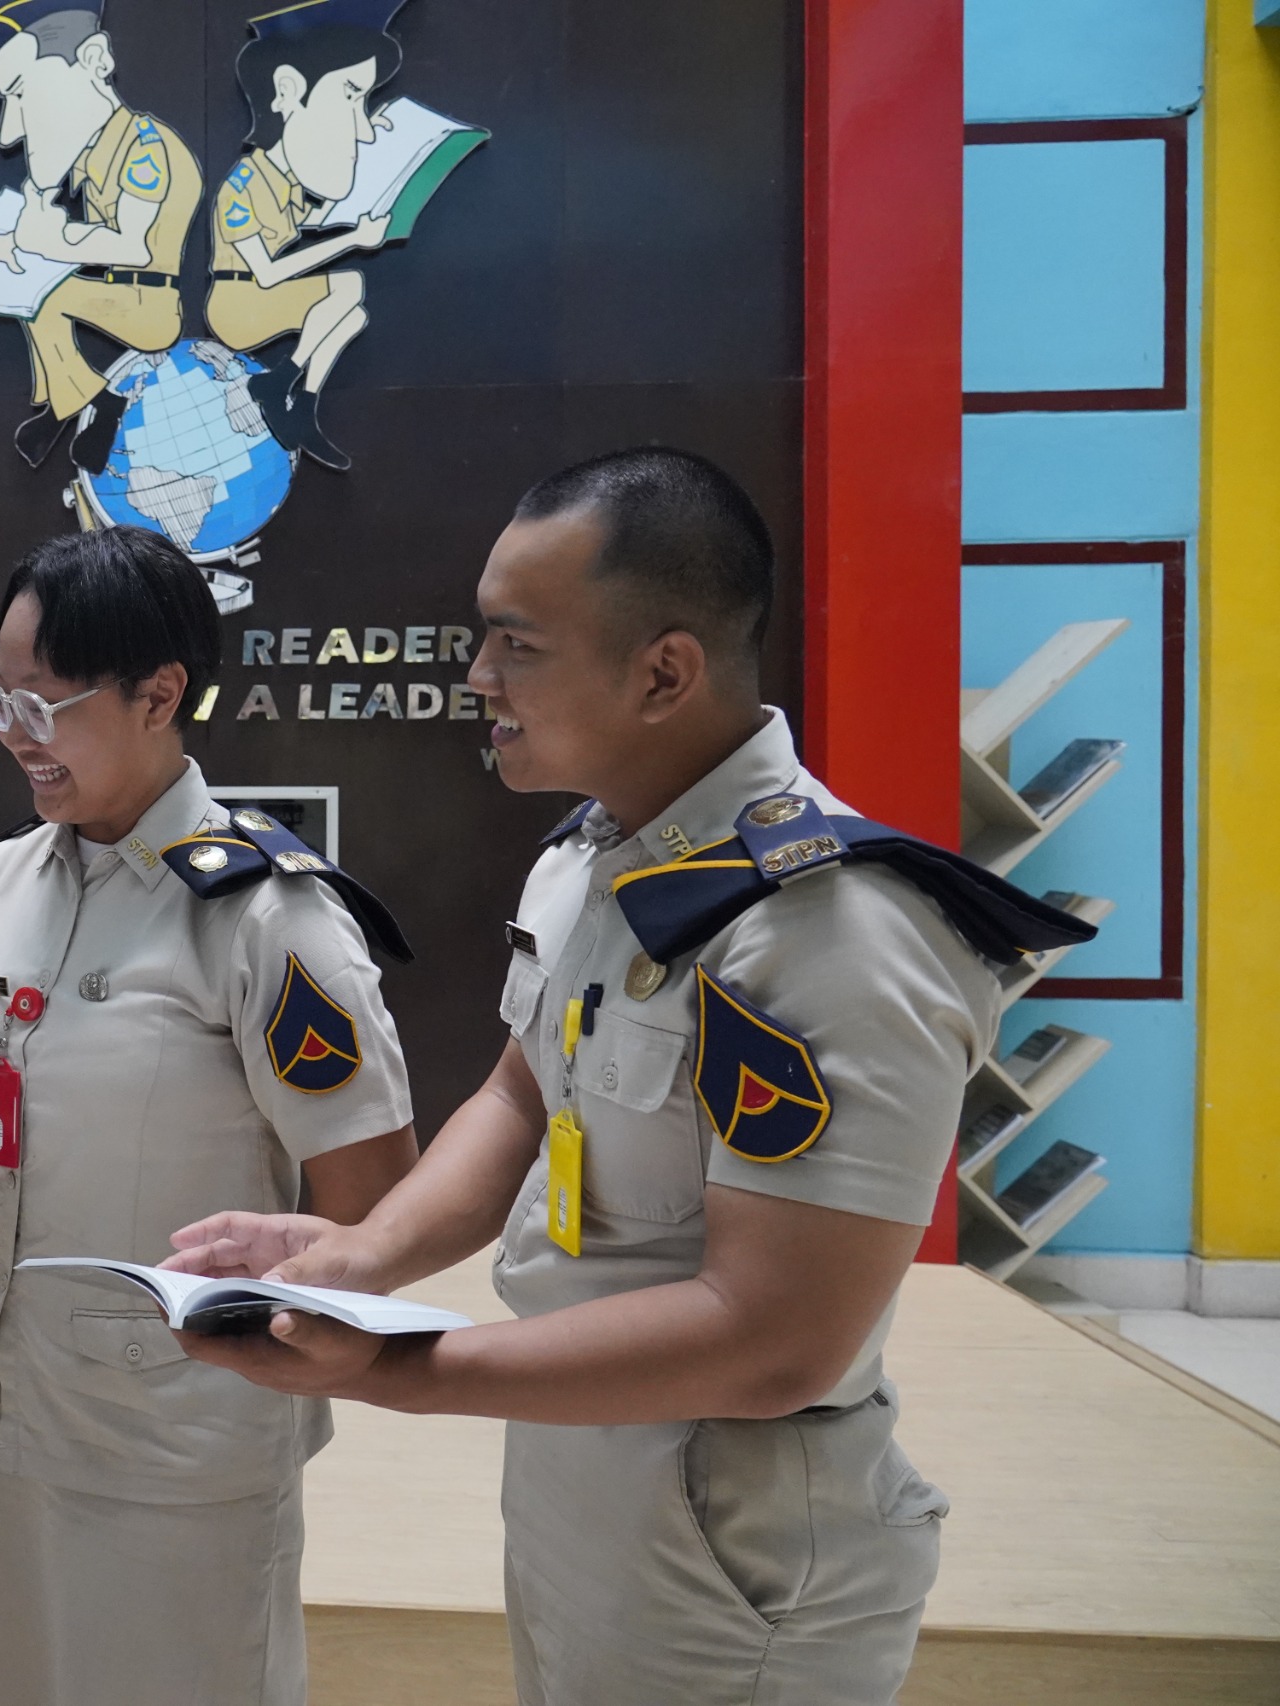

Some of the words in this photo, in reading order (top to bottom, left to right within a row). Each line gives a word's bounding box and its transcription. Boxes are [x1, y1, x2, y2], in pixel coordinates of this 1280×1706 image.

[242, 626, 473, 666] READER
[236, 683, 280, 721] A
[127, 836, 159, 871] STPN
[660, 823, 694, 856] STP
[762, 836, 842, 873] STPN
